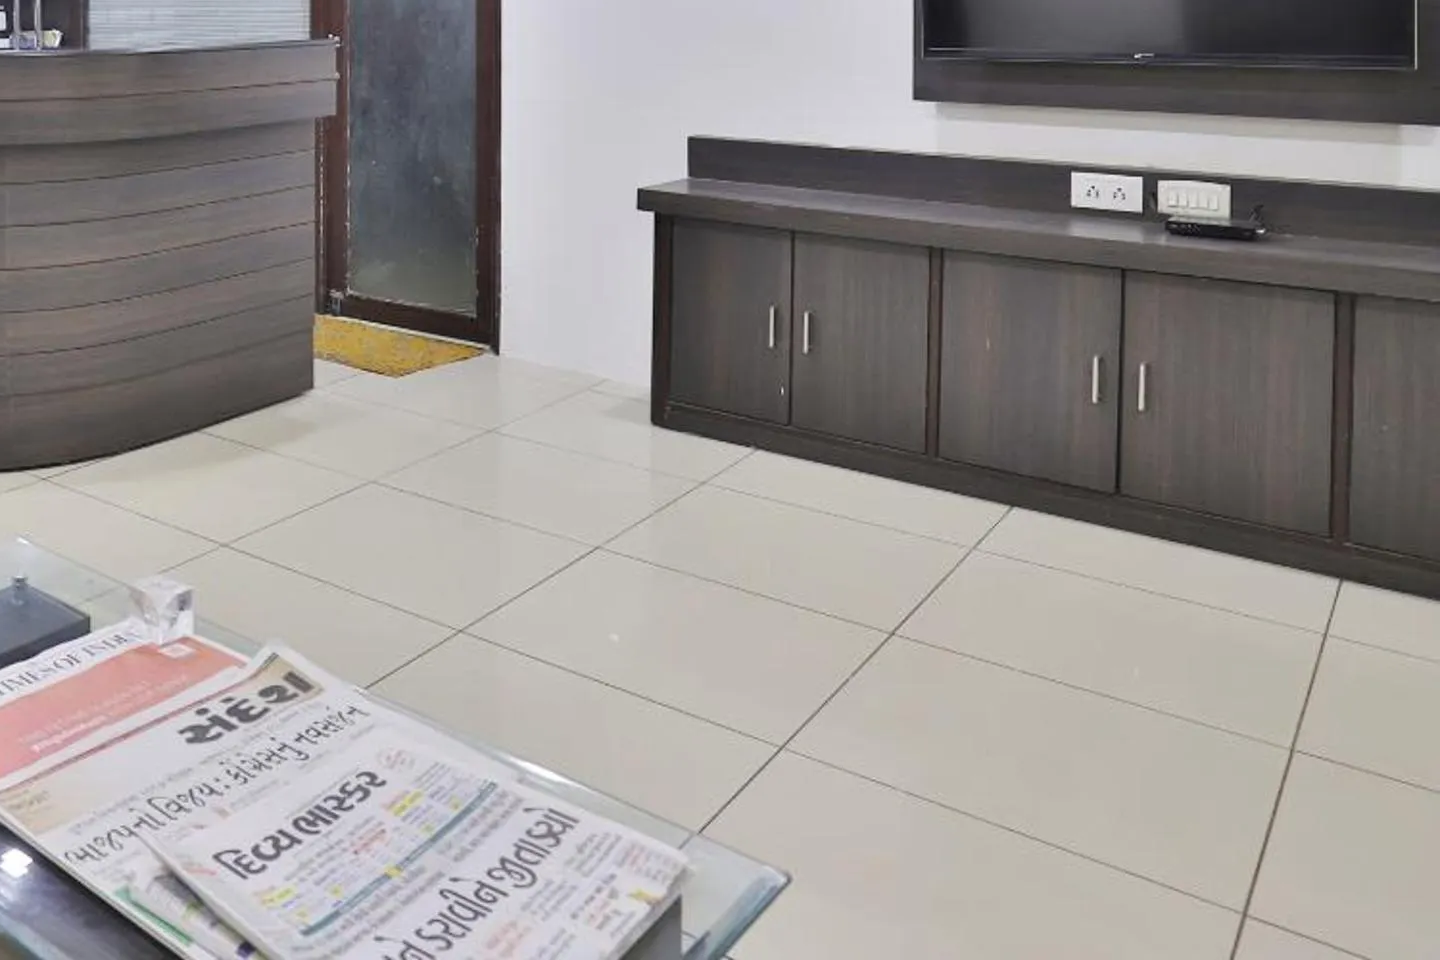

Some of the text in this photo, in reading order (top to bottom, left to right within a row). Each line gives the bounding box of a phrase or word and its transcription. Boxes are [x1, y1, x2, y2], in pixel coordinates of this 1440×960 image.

[54, 652, 83, 672] OF
[178, 671, 315, 744] સંદેશ
[291, 770, 388, 836] ભાસ્કર
